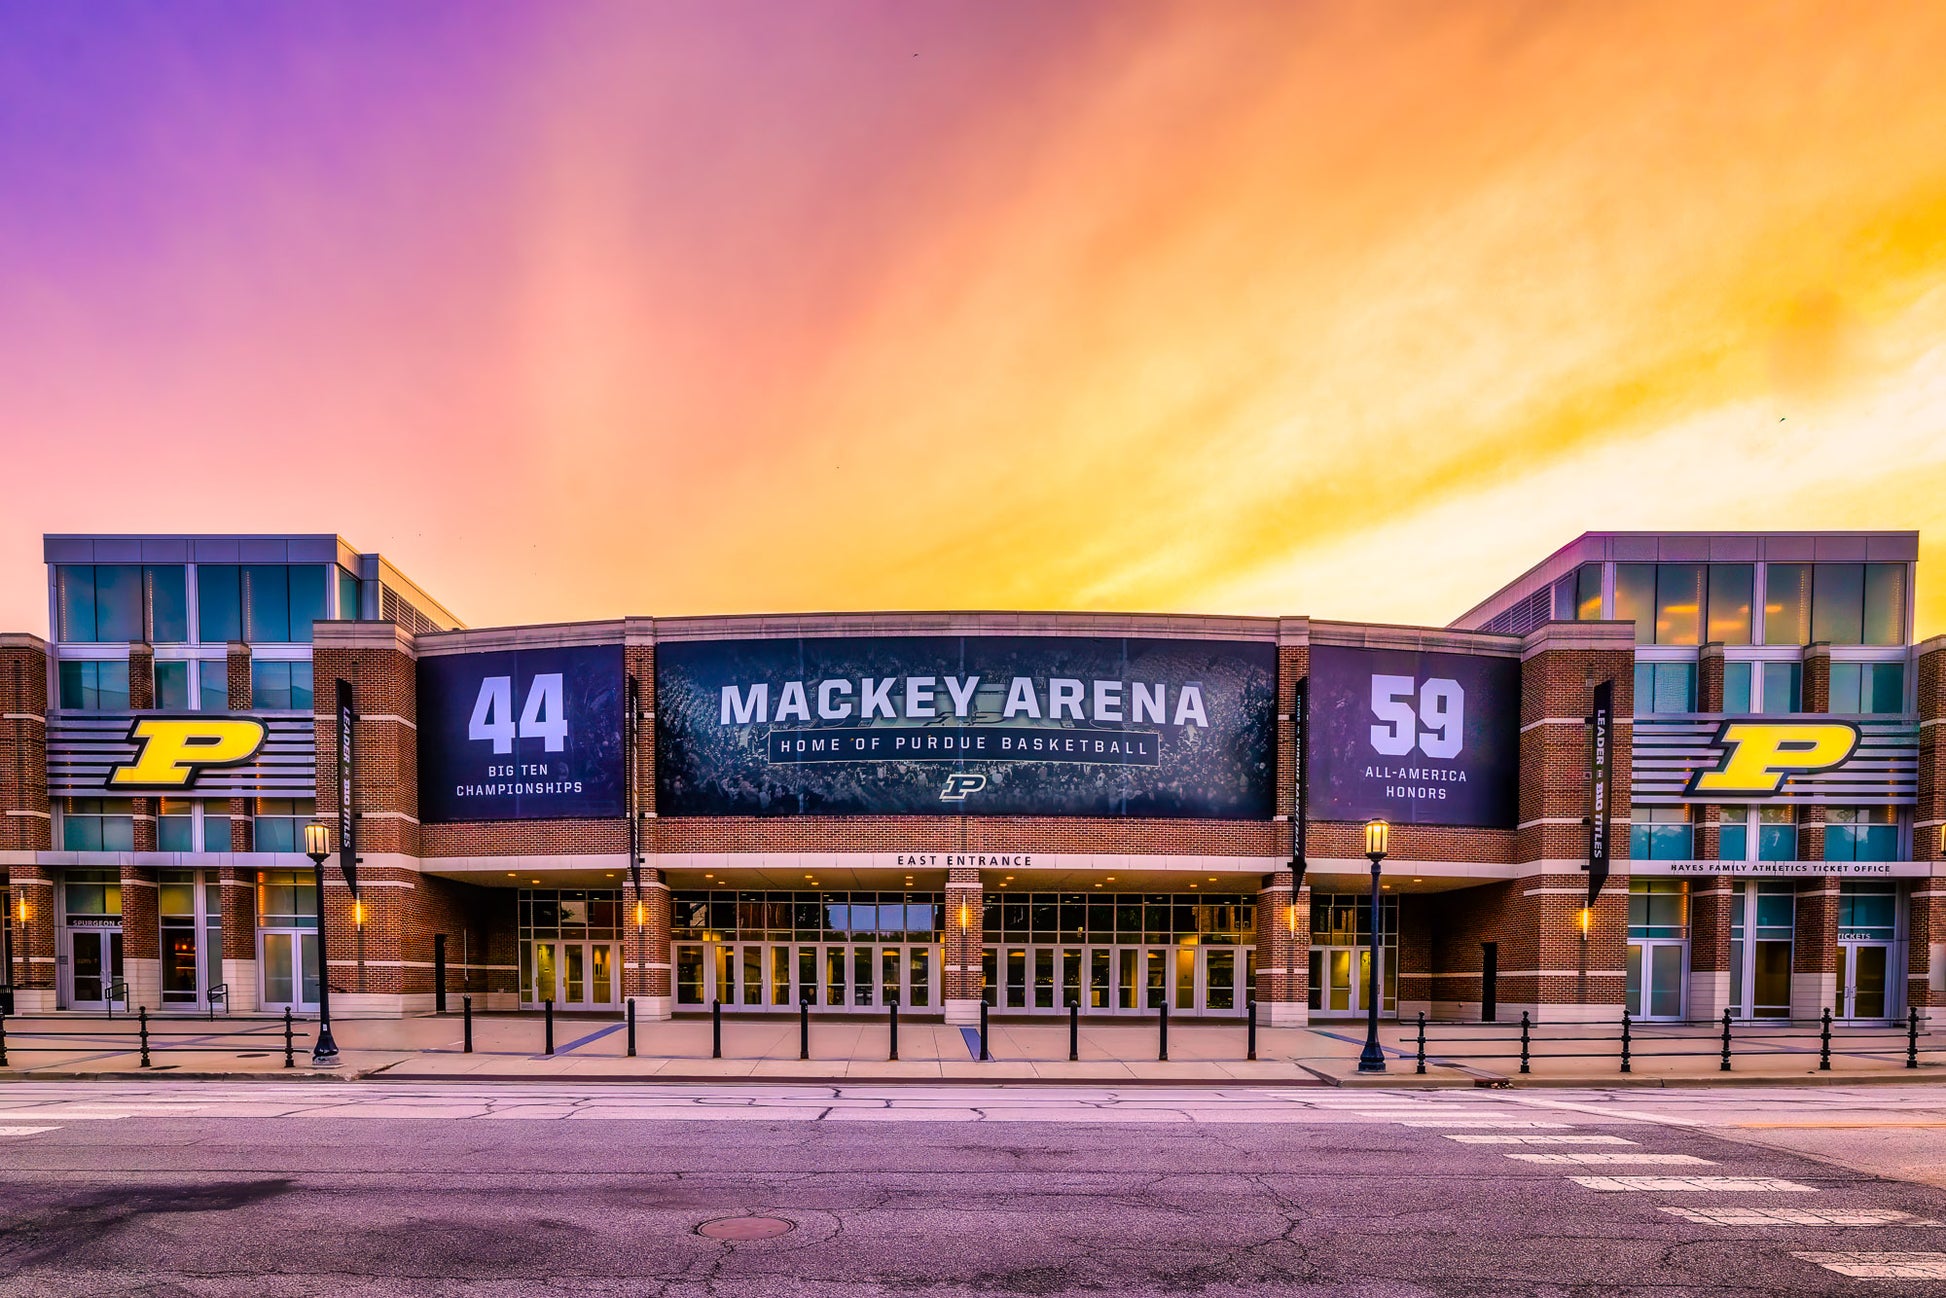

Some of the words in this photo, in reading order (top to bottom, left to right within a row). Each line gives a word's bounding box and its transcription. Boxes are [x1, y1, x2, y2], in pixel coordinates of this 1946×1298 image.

[469, 673, 568, 754] 44
[720, 676, 980, 725] MACKEY
[1003, 677, 1209, 727] ARENA
[1370, 674, 1465, 759] 59
[107, 717, 267, 788] P
[343, 706, 351, 764] LEADER
[780, 738, 840, 752] HOME
[855, 737, 880, 750] OF
[896, 736, 986, 750] PURDUE
[1002, 736, 1148, 756] BASKETBALL
[1596, 709, 1606, 765] LEADER
[488, 765, 514, 778] BIG
[521, 764, 548, 776] TEN
[1365, 766, 1467, 782] ALL-AMERICA
[1689, 721, 1860, 794] P
[456, 782, 582, 797] CHAMPIONSHIPS
[939, 774, 986, 802] P
[1386, 786, 1447, 800] HONORS
[1594, 812, 1603, 858] TITLES
[897, 856, 937, 866] EAST
[947, 856, 1032, 866] ENTRANCE
[1671, 864, 1704, 872] HAYES
[1709, 864, 1747, 872] FAMILY
[1752, 864, 1808, 872] ATHLETICS
